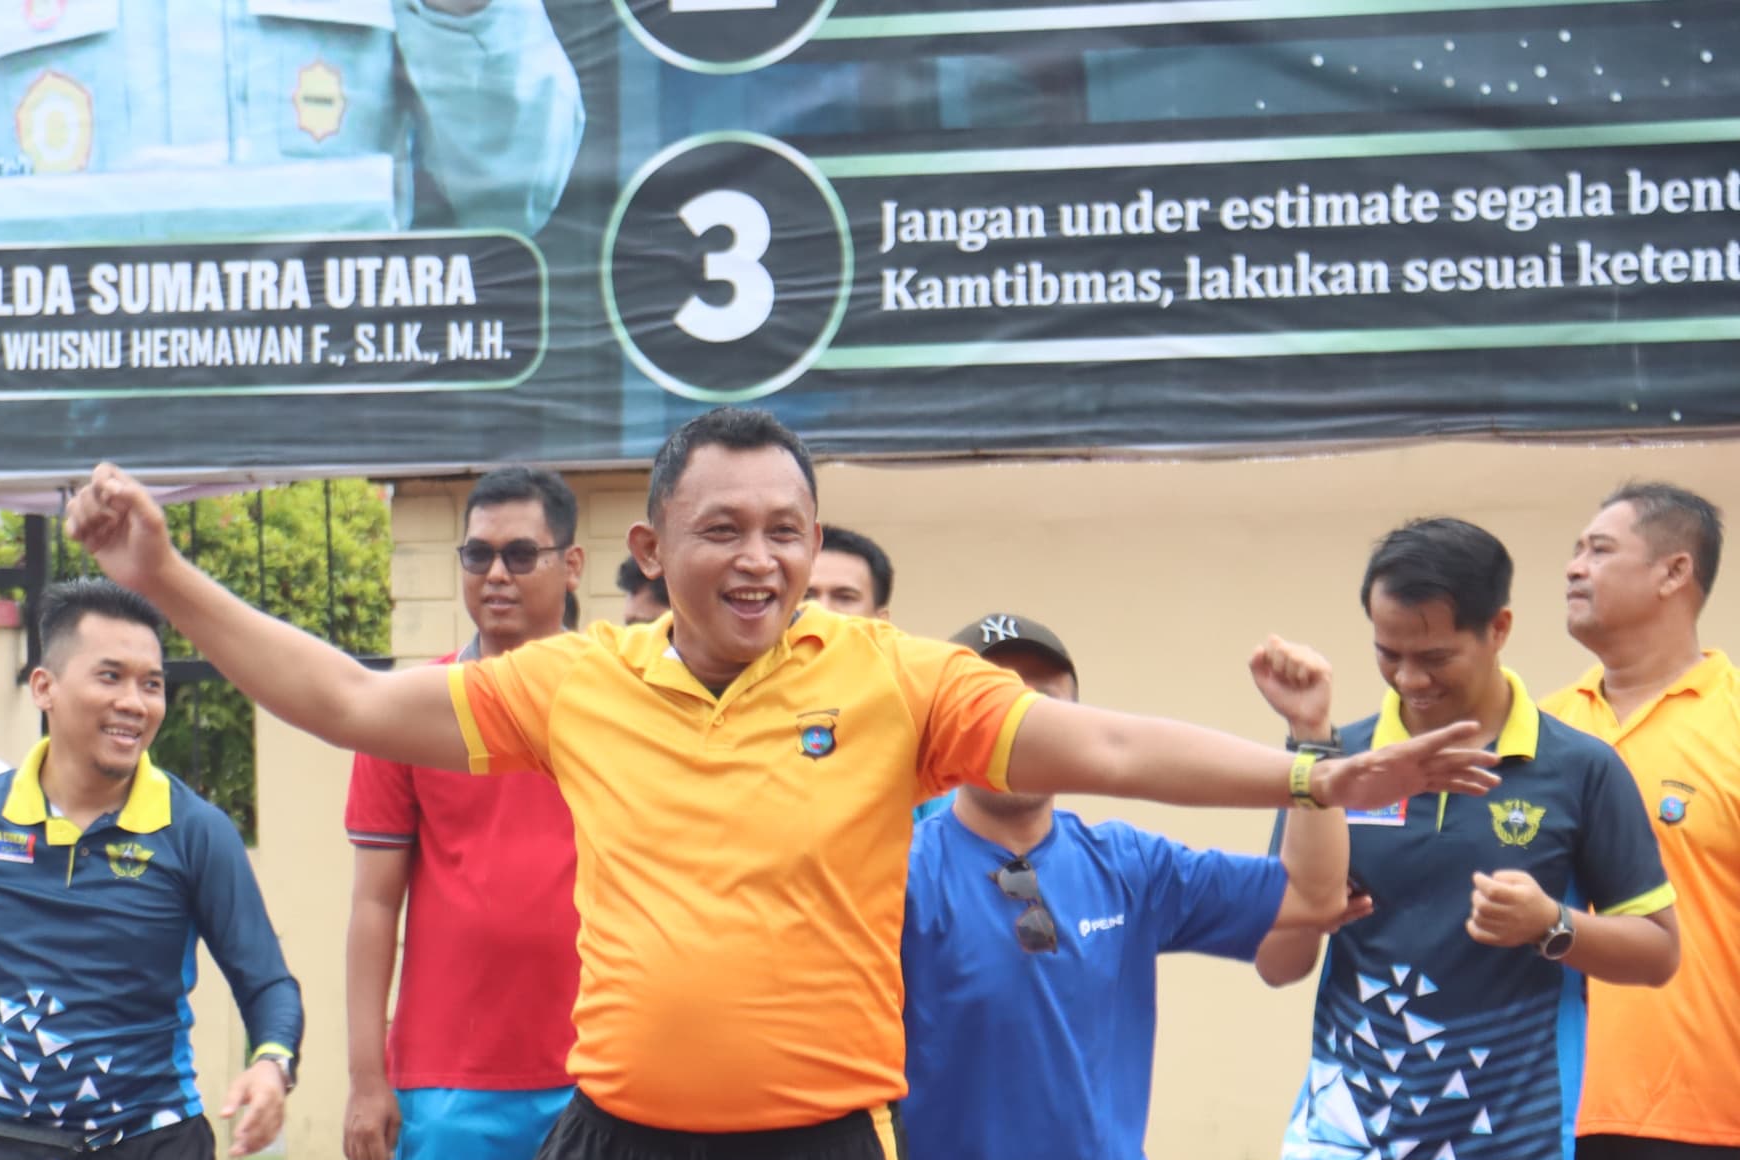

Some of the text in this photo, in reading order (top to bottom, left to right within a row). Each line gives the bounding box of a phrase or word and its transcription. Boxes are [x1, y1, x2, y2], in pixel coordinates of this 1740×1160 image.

[880, 200, 1047, 254] Jangan
[1059, 188, 1211, 237] under
[1219, 182, 1441, 231] estimate
[1451, 171, 1615, 232] segala
[88, 258, 313, 316] SUMATRA
[324, 254, 478, 309] UTARA
[672, 189, 776, 343] 3
[881, 260, 1175, 310] Kamtibmas,
[1186, 250, 1391, 301] lakukan
[1402, 242, 1565, 294] sesuai
[1, 329, 123, 372] WHISNU
[128, 325, 304, 368] HERMAWAN
[446, 320, 513, 362] M.H.
